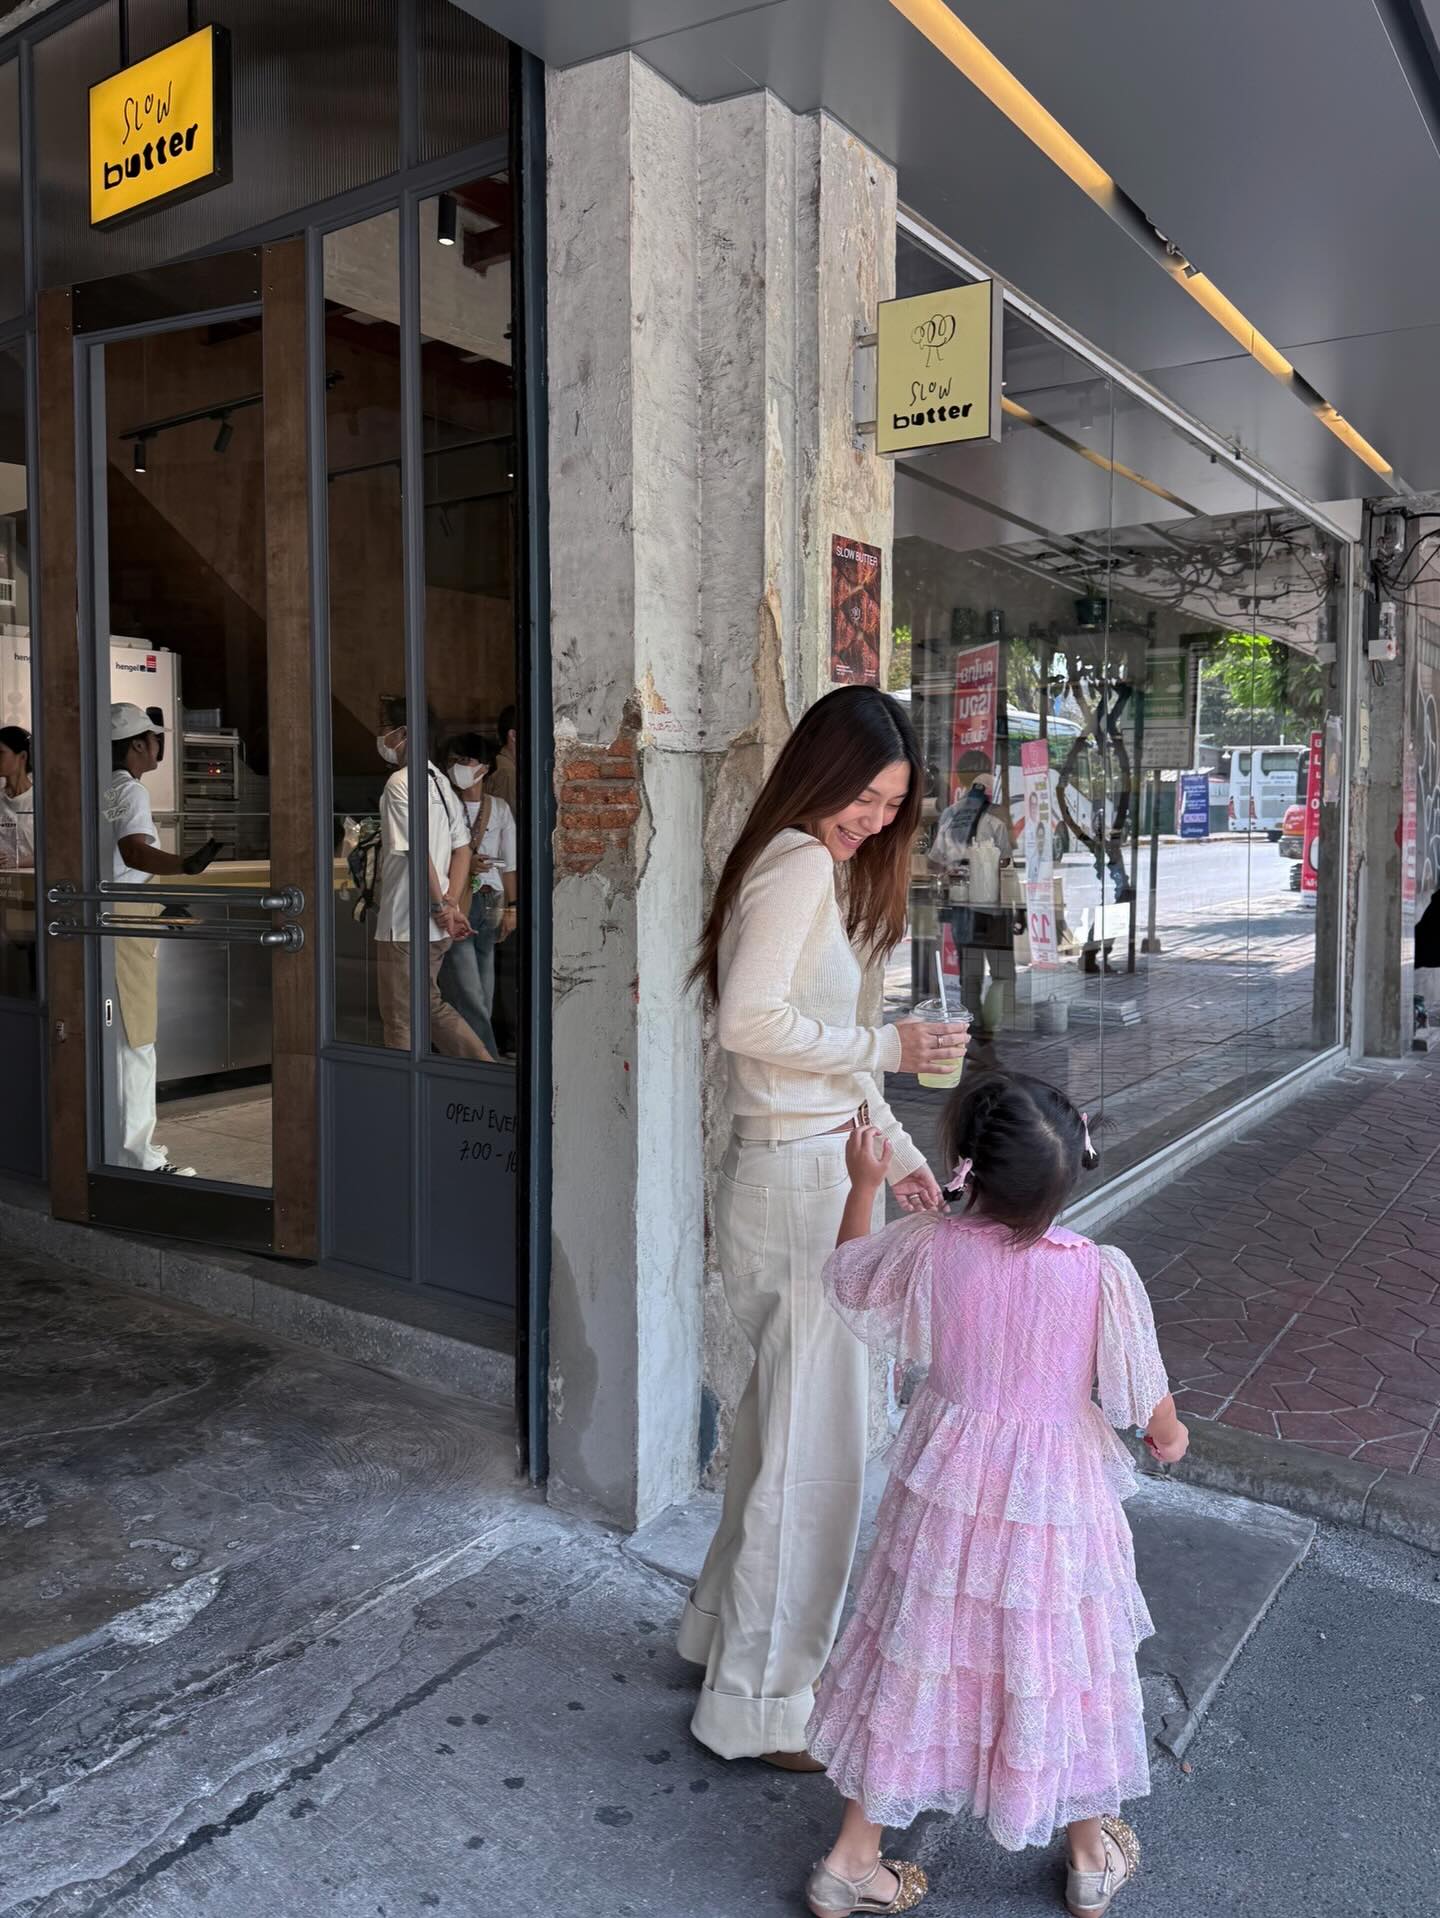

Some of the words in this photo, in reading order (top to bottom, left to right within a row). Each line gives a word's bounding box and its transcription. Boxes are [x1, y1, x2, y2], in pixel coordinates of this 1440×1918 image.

[103, 122, 199, 190] butter
[893, 403, 973, 430] butter
[836, 545, 855, 560] SLOW
[855, 551, 878, 567] BUTTER
[115, 662, 140, 672] hengel
[446, 1102, 484, 1125] OPEN
